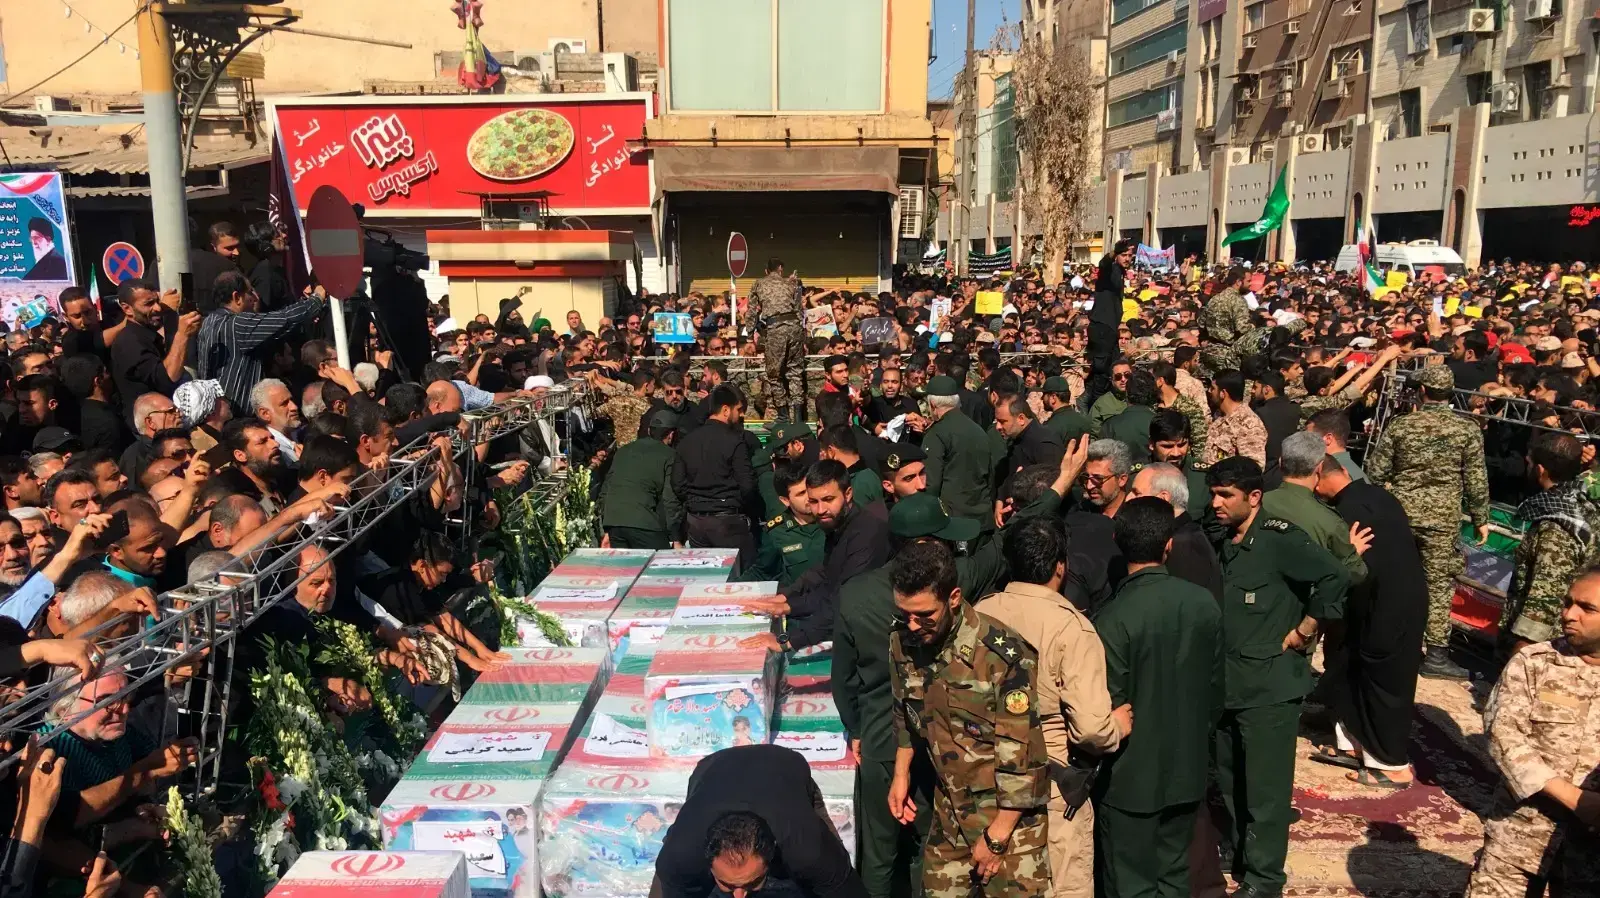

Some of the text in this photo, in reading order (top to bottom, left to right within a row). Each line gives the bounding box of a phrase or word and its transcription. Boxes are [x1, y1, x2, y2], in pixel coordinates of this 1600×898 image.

[292, 141, 344, 183] خانوادگی
[351, 114, 413, 168] پیتزا
[368, 150, 437, 201] اکسپرس
[445, 746, 532, 755] سعید کریمی
[443, 828, 476, 843] شهید
